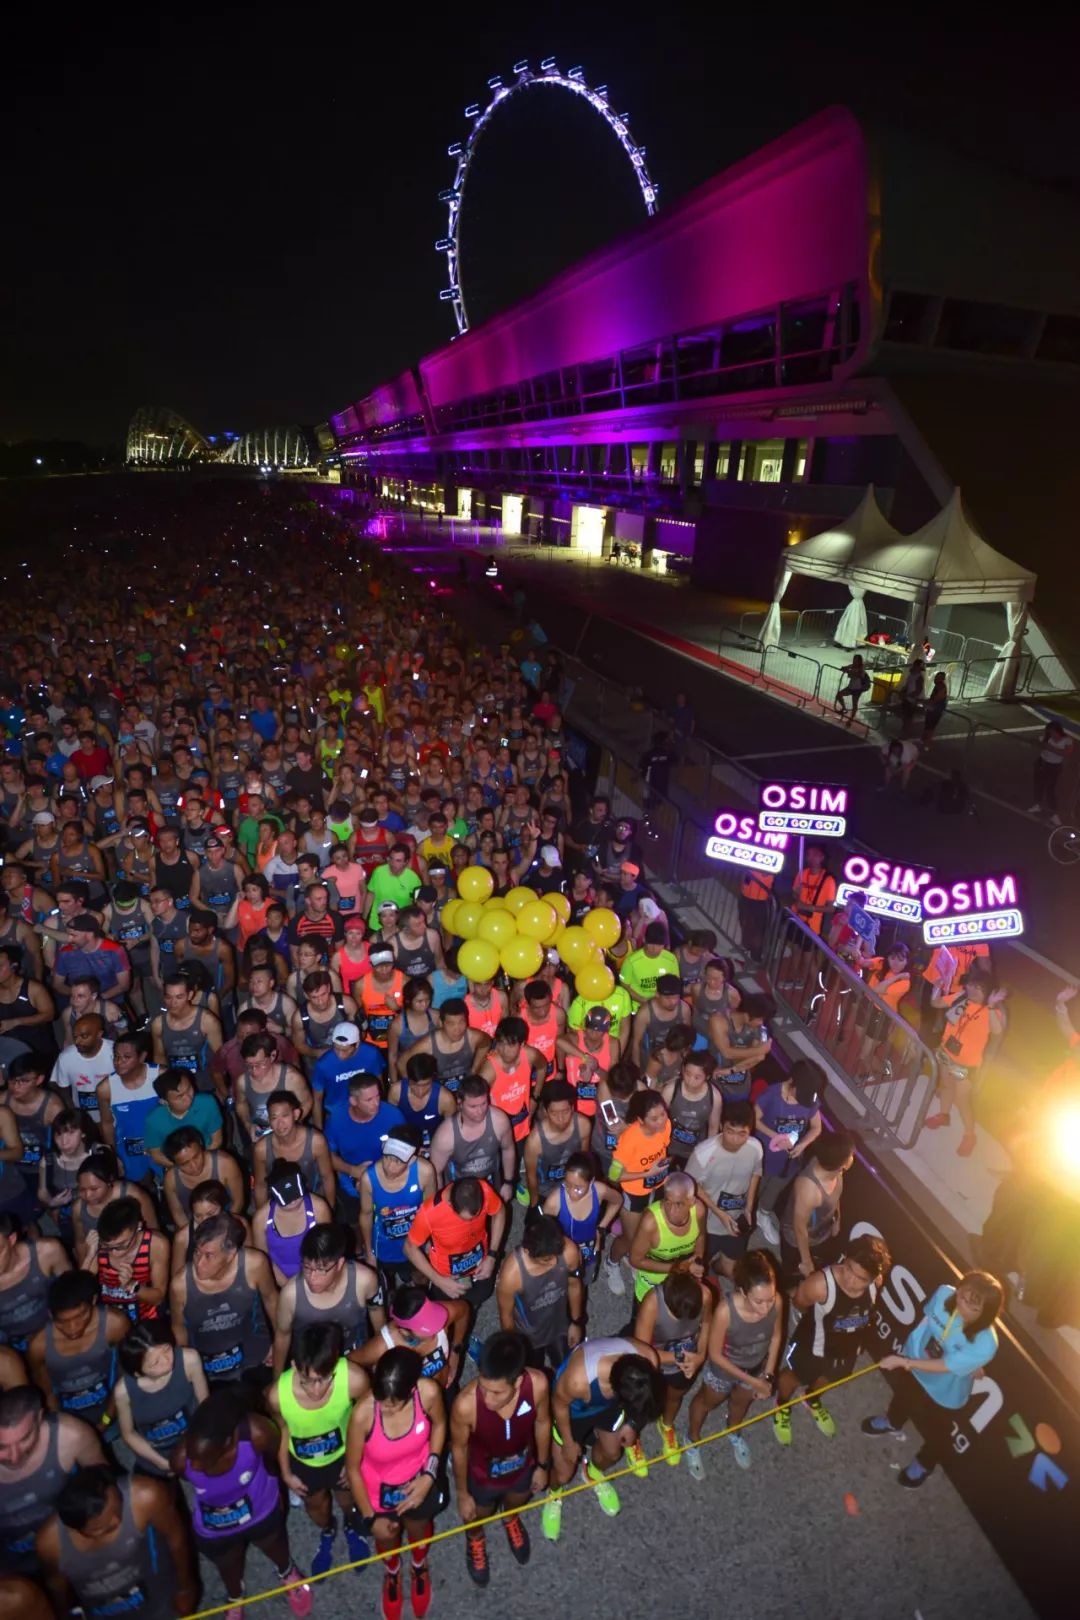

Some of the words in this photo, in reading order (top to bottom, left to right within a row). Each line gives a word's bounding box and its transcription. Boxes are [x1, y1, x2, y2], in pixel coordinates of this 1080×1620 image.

[762, 785, 847, 812] OSIM
[715, 813, 788, 849] OSIM
[767, 817, 789, 827] GO!
[791, 818, 813, 829] GO!
[815, 820, 838, 831] GO!
[844, 856, 931, 896] OSIM
[868, 897, 891, 909] GO!
[893, 902, 917, 916] GO!
[923, 875, 1017, 915] OSIM
[931, 923, 956, 937] GO!
[958, 920, 983, 934] GO!
[986, 916, 1013, 931] GO!
